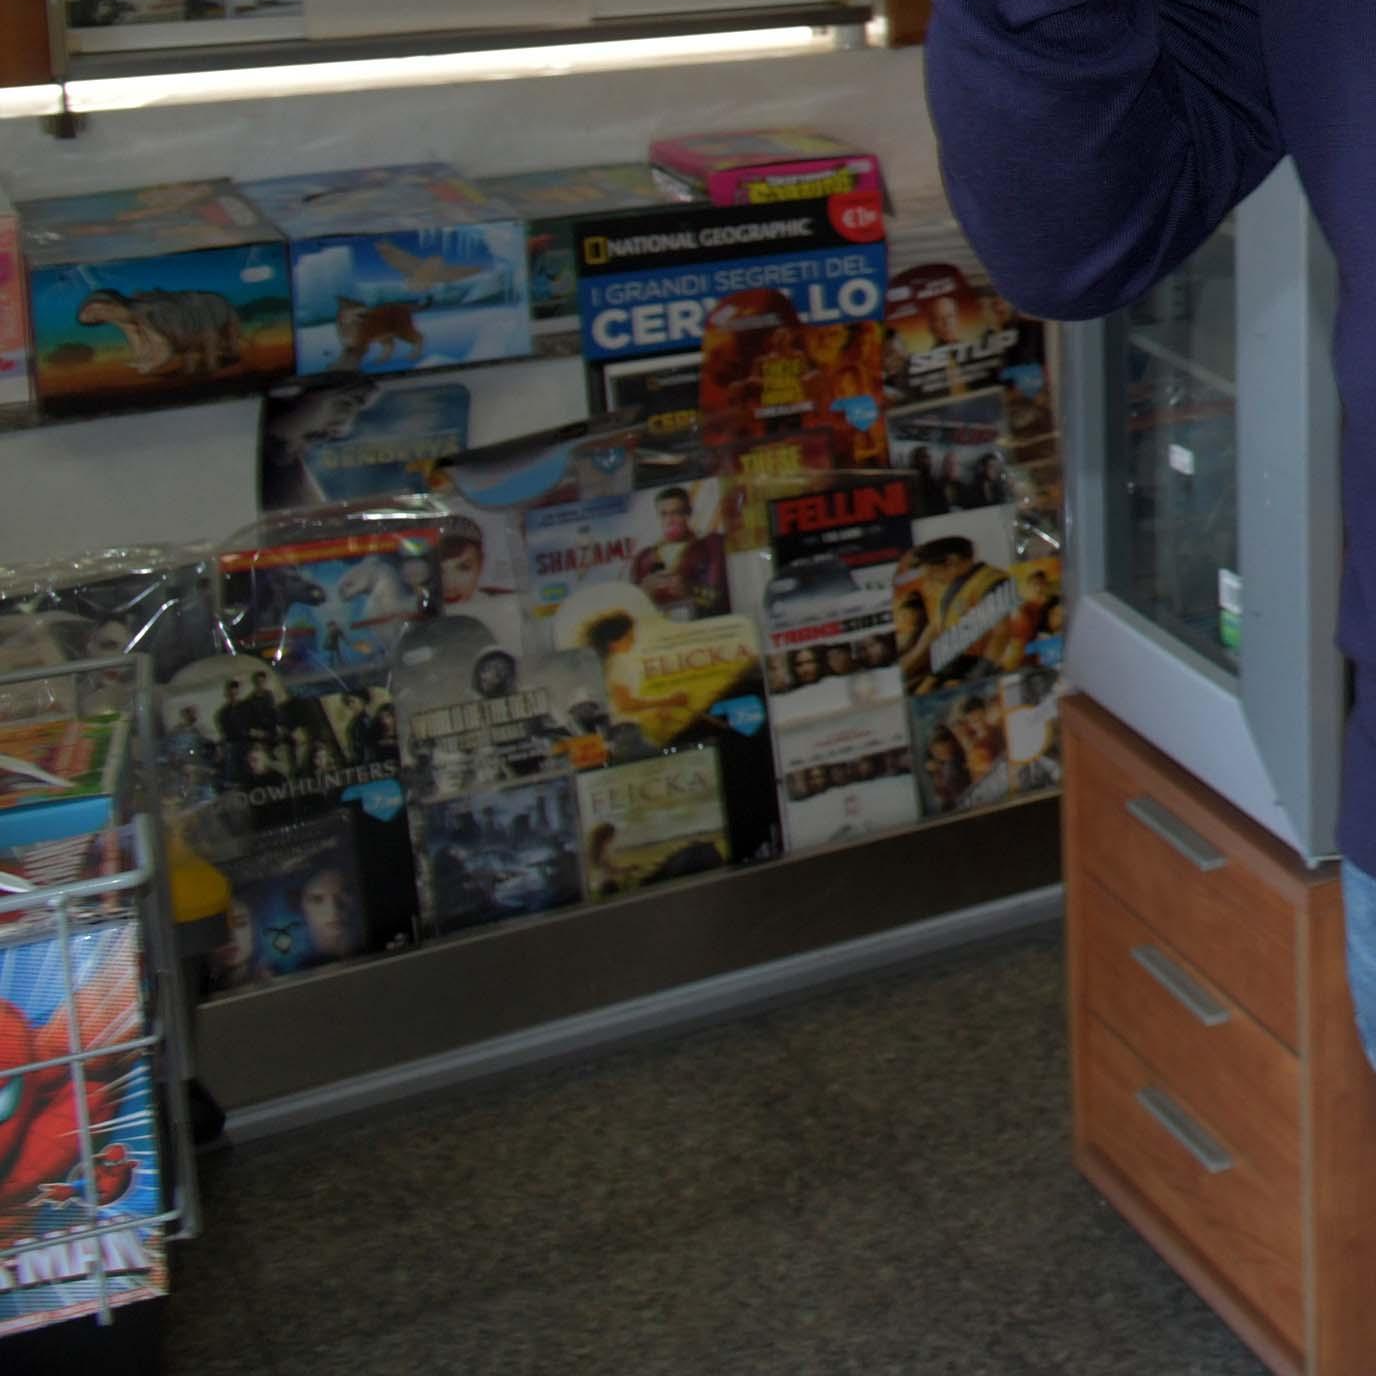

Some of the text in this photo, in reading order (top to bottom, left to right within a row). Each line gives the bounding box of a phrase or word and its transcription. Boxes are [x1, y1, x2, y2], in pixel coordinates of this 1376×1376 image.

[607, 217, 815, 261] NATIONAL GEOGRAPHIC
[600, 272, 711, 307] GRANDI
[711, 262, 822, 298] SEGRETI
[823, 252, 874, 279] DEL
[777, 483, 911, 536] FELLINI
[2, 1228, 152, 1292] MAN
